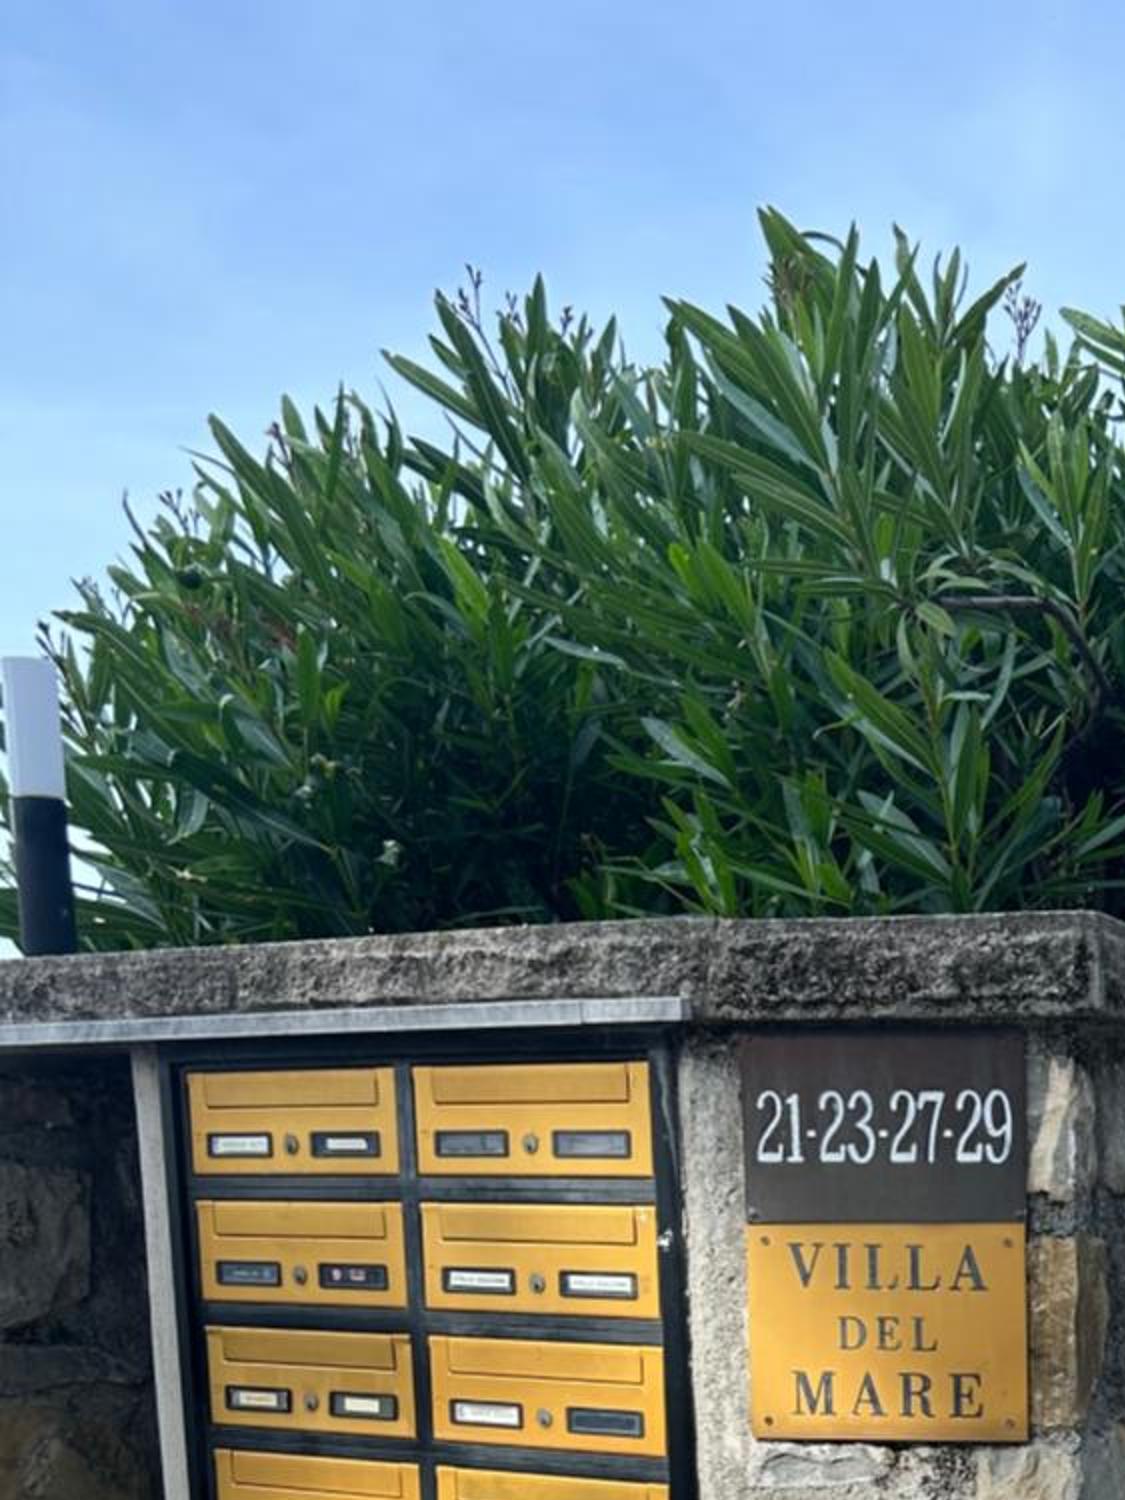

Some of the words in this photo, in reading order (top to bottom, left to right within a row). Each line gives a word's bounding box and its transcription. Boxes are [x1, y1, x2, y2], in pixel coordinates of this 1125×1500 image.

[788, 1242, 988, 1292] VILLA
[838, 1315, 939, 1352] DEL
[791, 1369, 985, 1419] MARE
